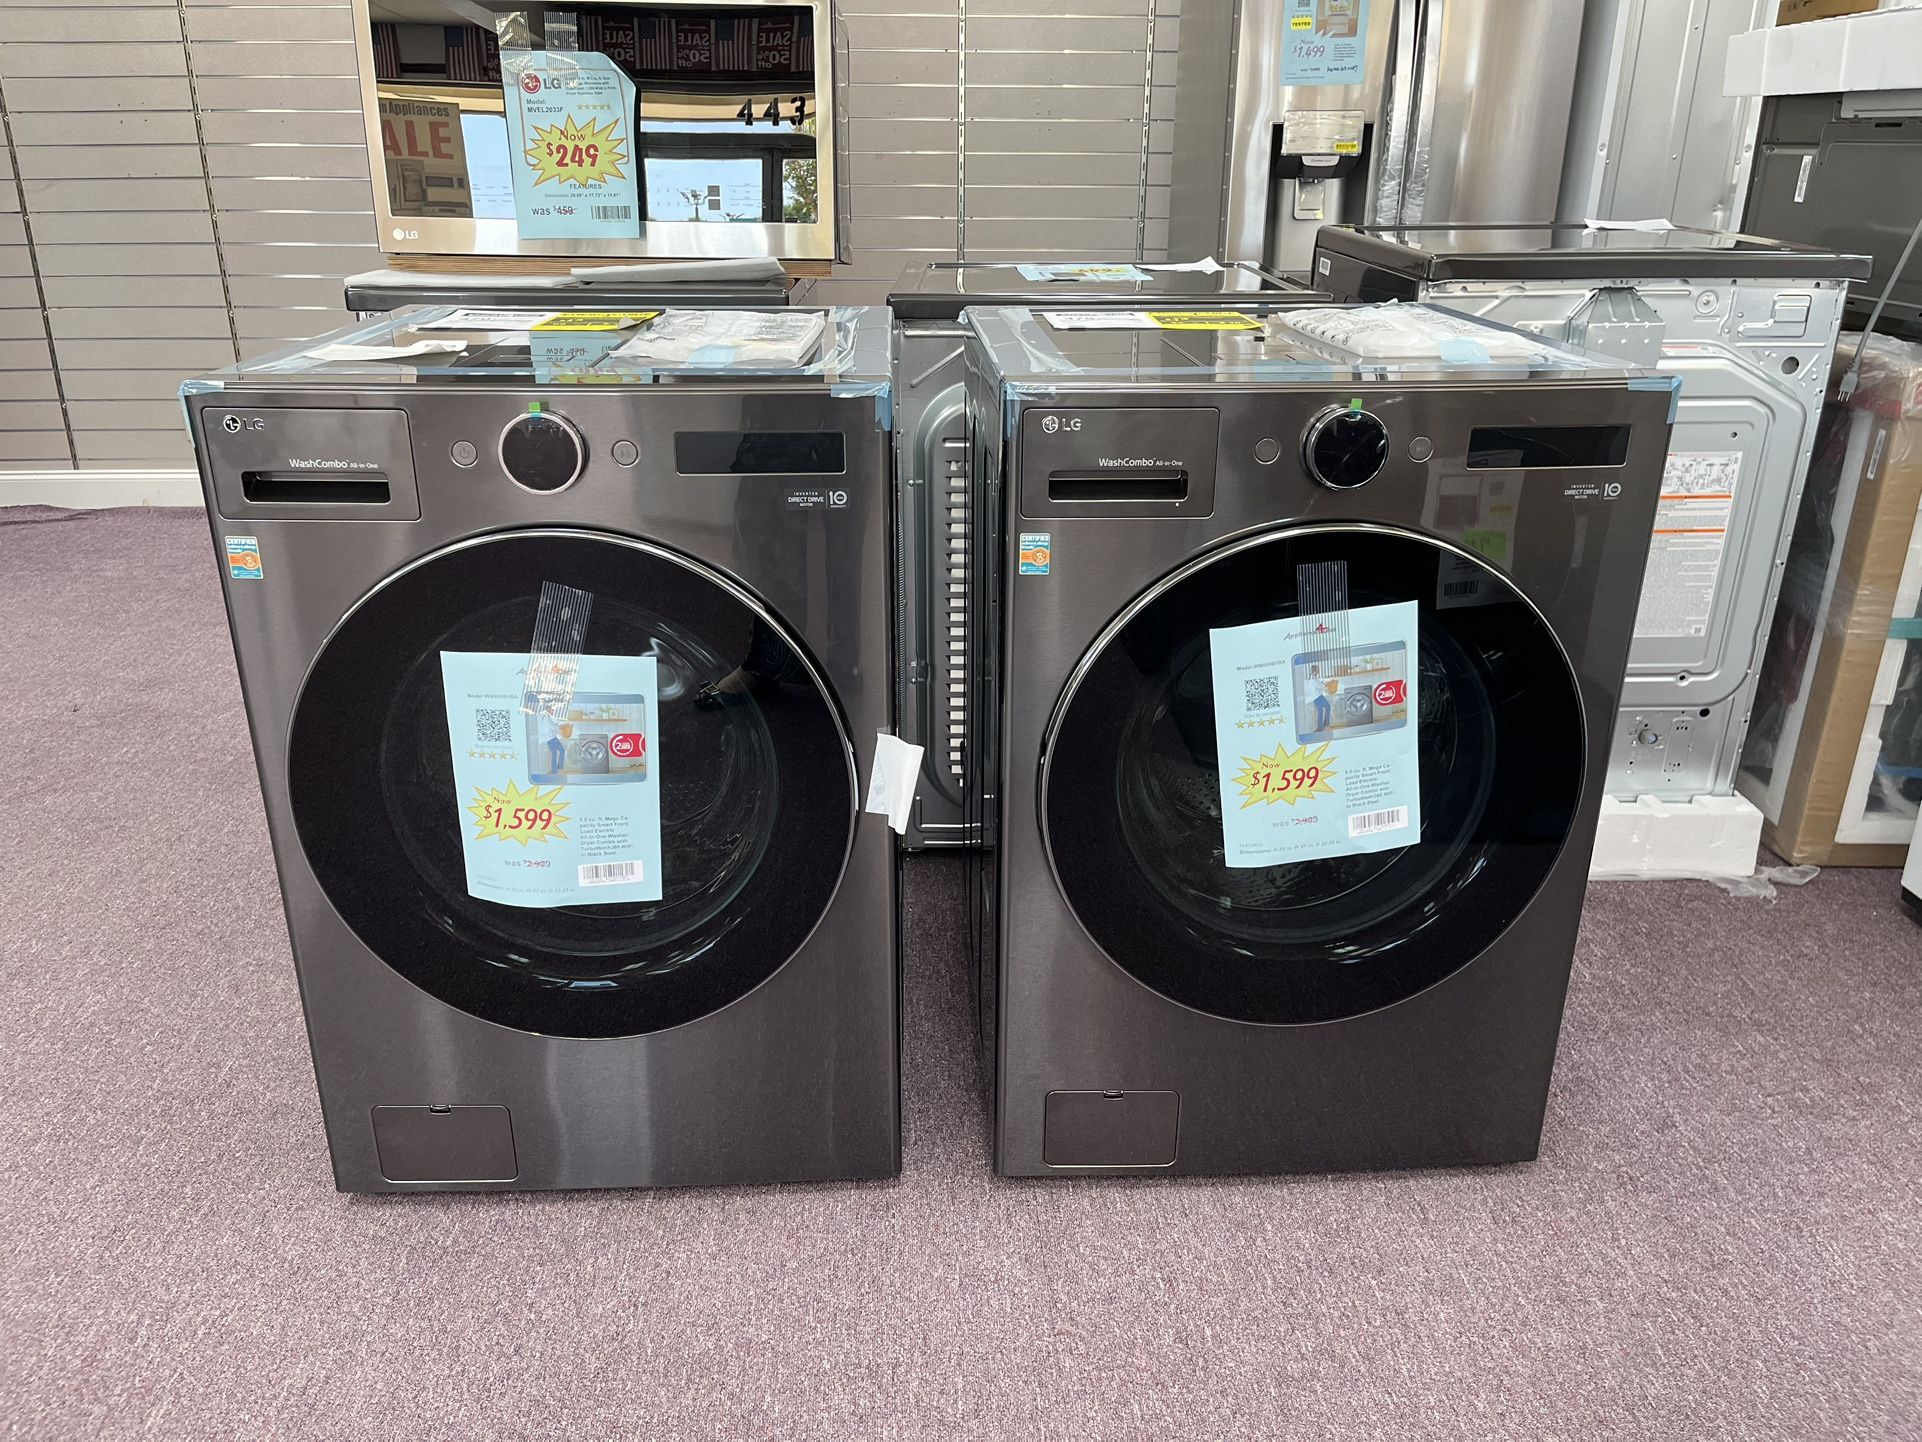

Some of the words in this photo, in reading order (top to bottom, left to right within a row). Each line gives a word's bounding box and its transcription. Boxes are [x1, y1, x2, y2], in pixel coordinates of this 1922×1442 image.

[543, 78, 562, 90] LG
[389, 102, 450, 117] Appliances
[381, 119, 454, 160] ALE
[559, 130, 587, 142] Now
[546, 141, 600, 168] $249
[531, 207, 551, 216] was
[405, 230, 419, 240] LG
[243, 417, 265, 431] LG
[1062, 418, 1082, 432] LG
[1261, 761, 1280, 770] Now
[1250, 766, 1320, 794] $1,599
[493, 796, 512, 805] Now
[483, 804, 553, 831] $1,599
[1272, 820, 1289, 828] was
